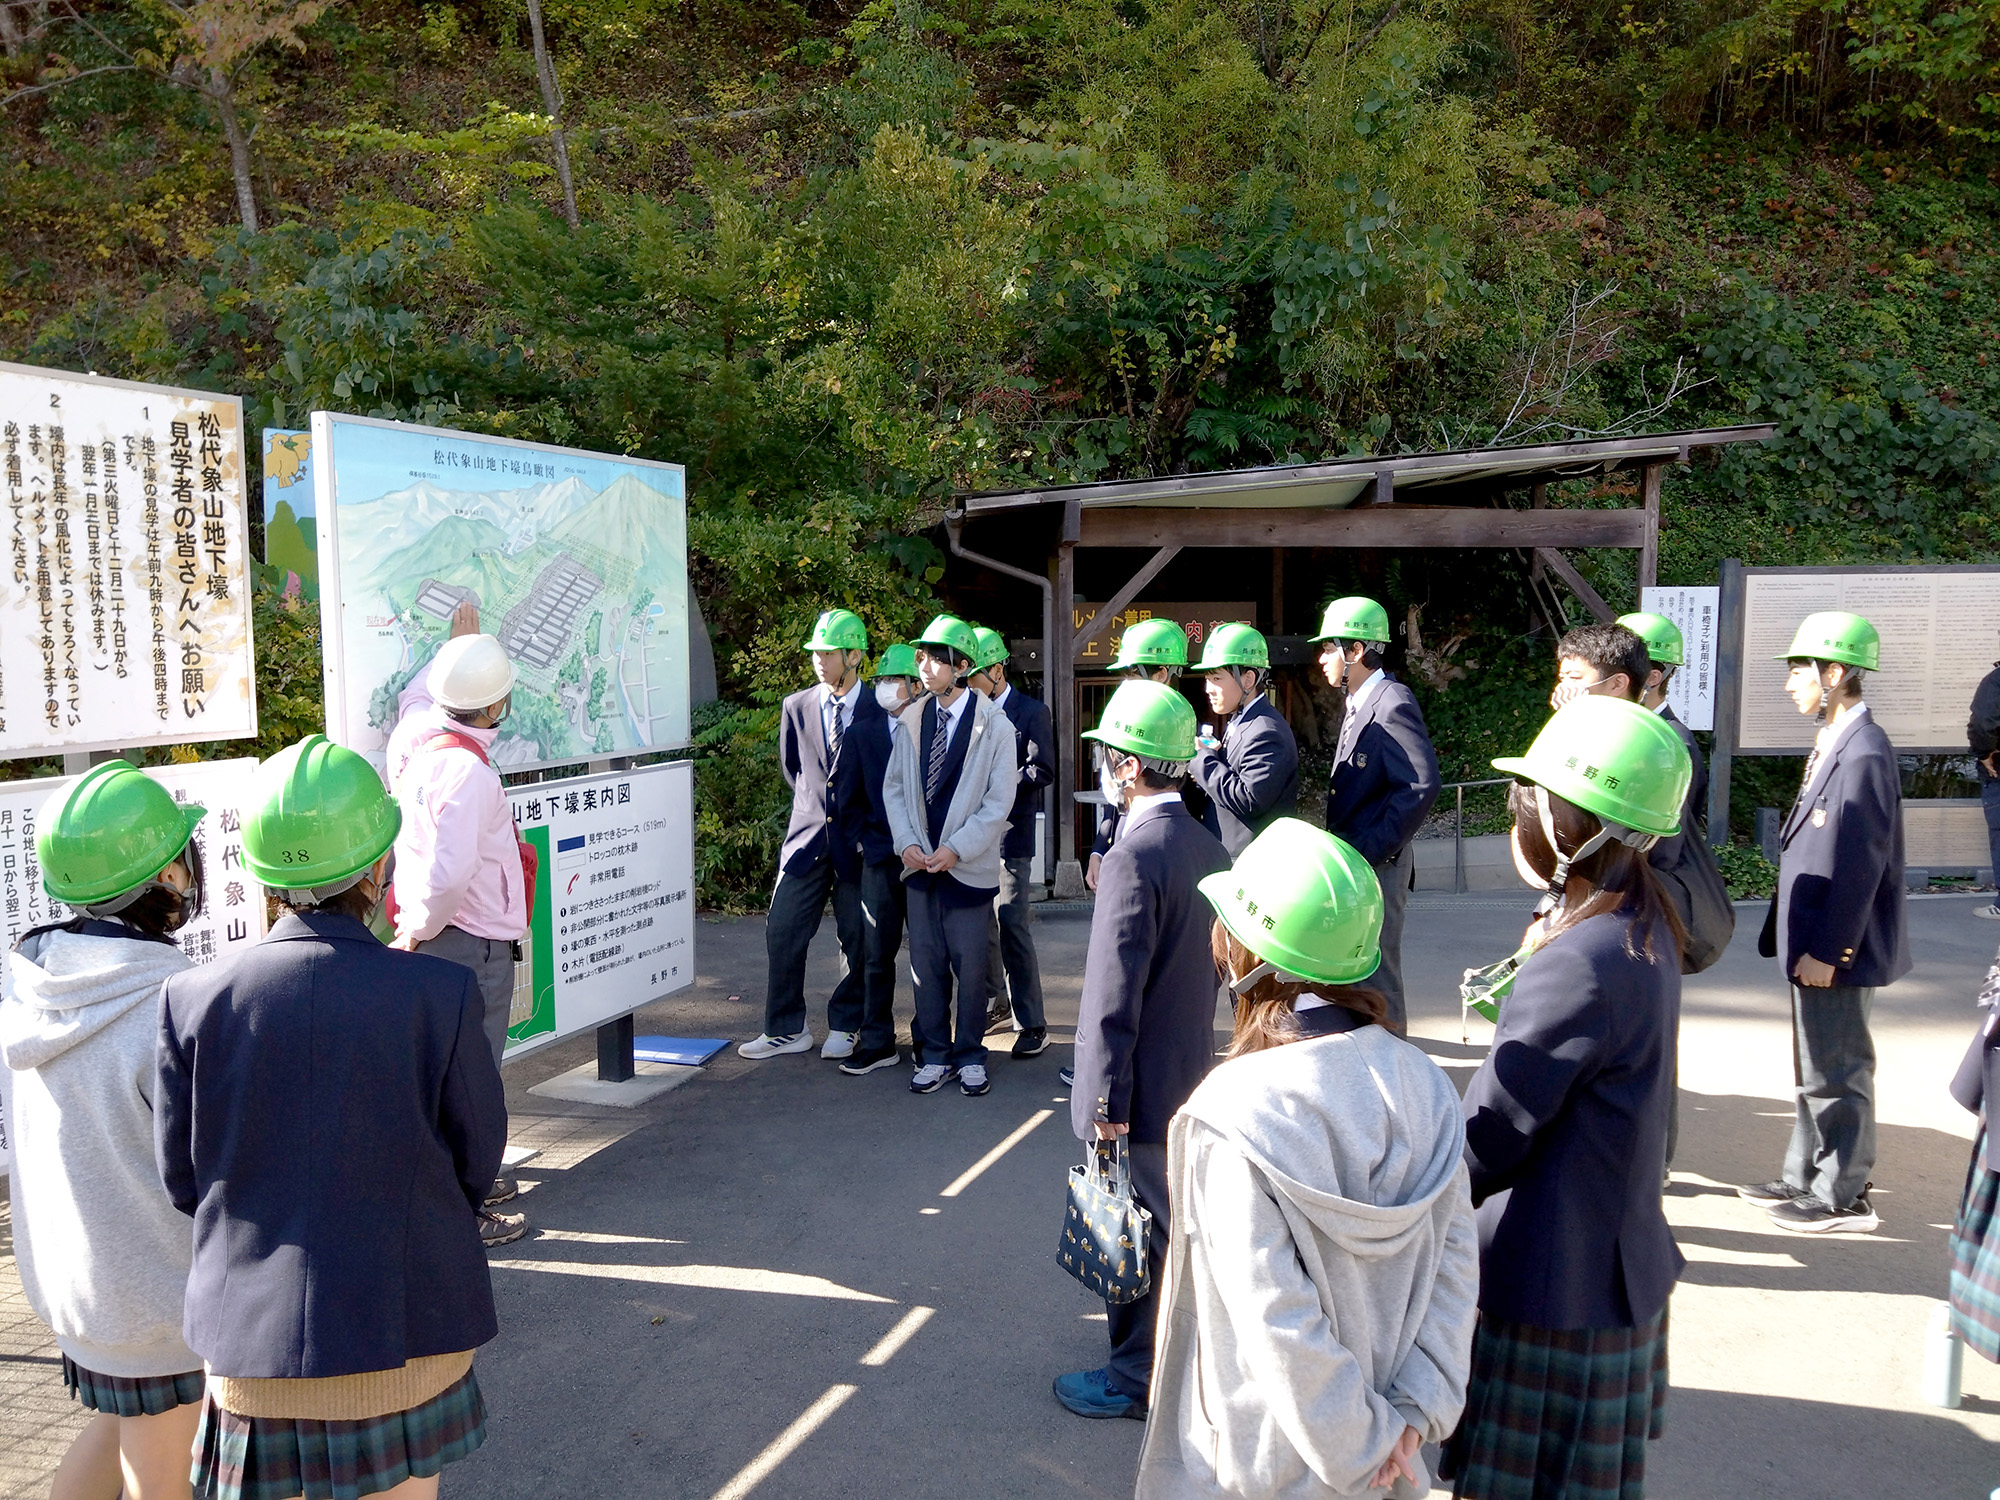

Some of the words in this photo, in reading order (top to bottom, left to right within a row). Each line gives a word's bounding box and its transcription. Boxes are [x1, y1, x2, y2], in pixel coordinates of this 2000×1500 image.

[122, 435, 138, 472] です。
[433, 448, 556, 480] 松代象山地下壕鳥瞰図
[4, 420, 31, 592] 必ず着用してください。
[198, 411, 229, 600] 松代象山地下壕
[28, 424, 60, 728] ます。ヘルメットを用意してありますので
[49, 426, 81, 728] 壕内は長年の風化によってもろくなってい
[141, 436, 169, 720] 地下壕の見学は午前九時から午後四時まで
[170, 422, 206, 719] 見学者の皆さんへお願い
[1697, 605, 1712, 700] 車椅子ご利用の皆様へ
[1564, 755, 1621, 791] 長野市
[281, 848, 310, 864] 38
[589, 866, 626, 886] 非常用電話
[1235, 887, 1277, 931] 長野市
[650, 966, 679, 986] 長野市
